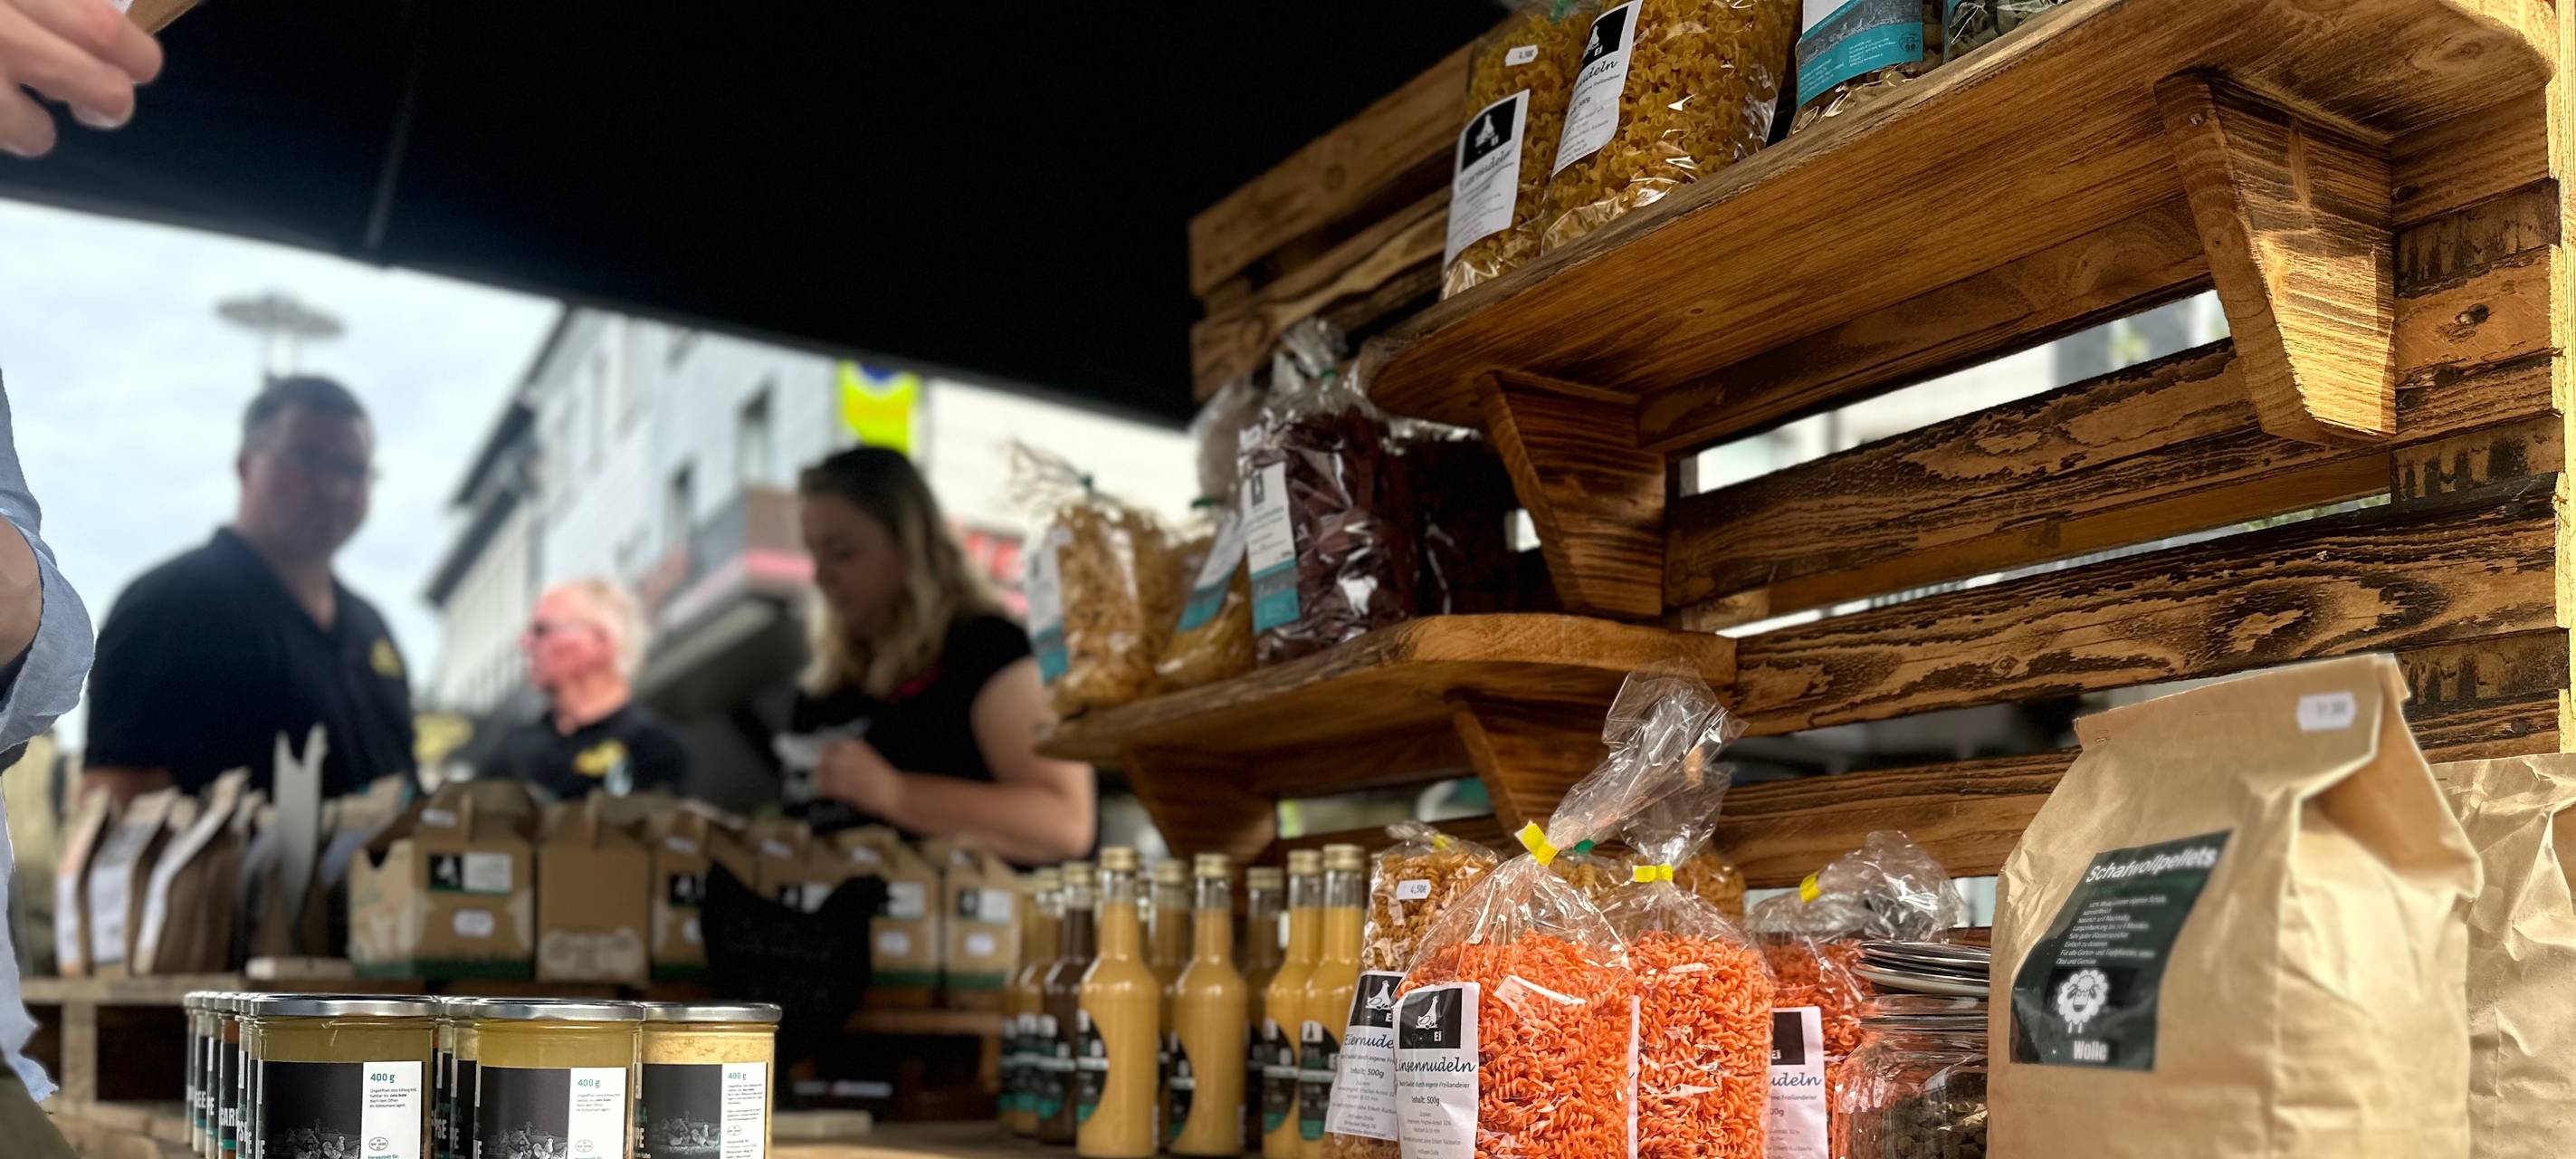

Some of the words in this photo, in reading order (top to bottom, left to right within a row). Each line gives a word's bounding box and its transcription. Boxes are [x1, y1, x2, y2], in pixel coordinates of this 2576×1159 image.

[2085, 847, 2218, 883] Schafwollpellets
[1343, 1034, 1393, 1049] Eiernude
[2073, 1040, 2108, 1061] Wolle
[1395, 1056, 1476, 1073] Linsennudeln
[370, 1073, 387, 1082] 400
[389, 1074, 396, 1084] g
[1367, 1068, 1385, 1078] 500g
[1770, 1072, 1822, 1087] udeln
[577, 1078, 593, 1087] 400
[595, 1079, 600, 1089] g
[1426, 1096, 1440, 1106] 500g
[1770, 1107, 1785, 1117] 00g
